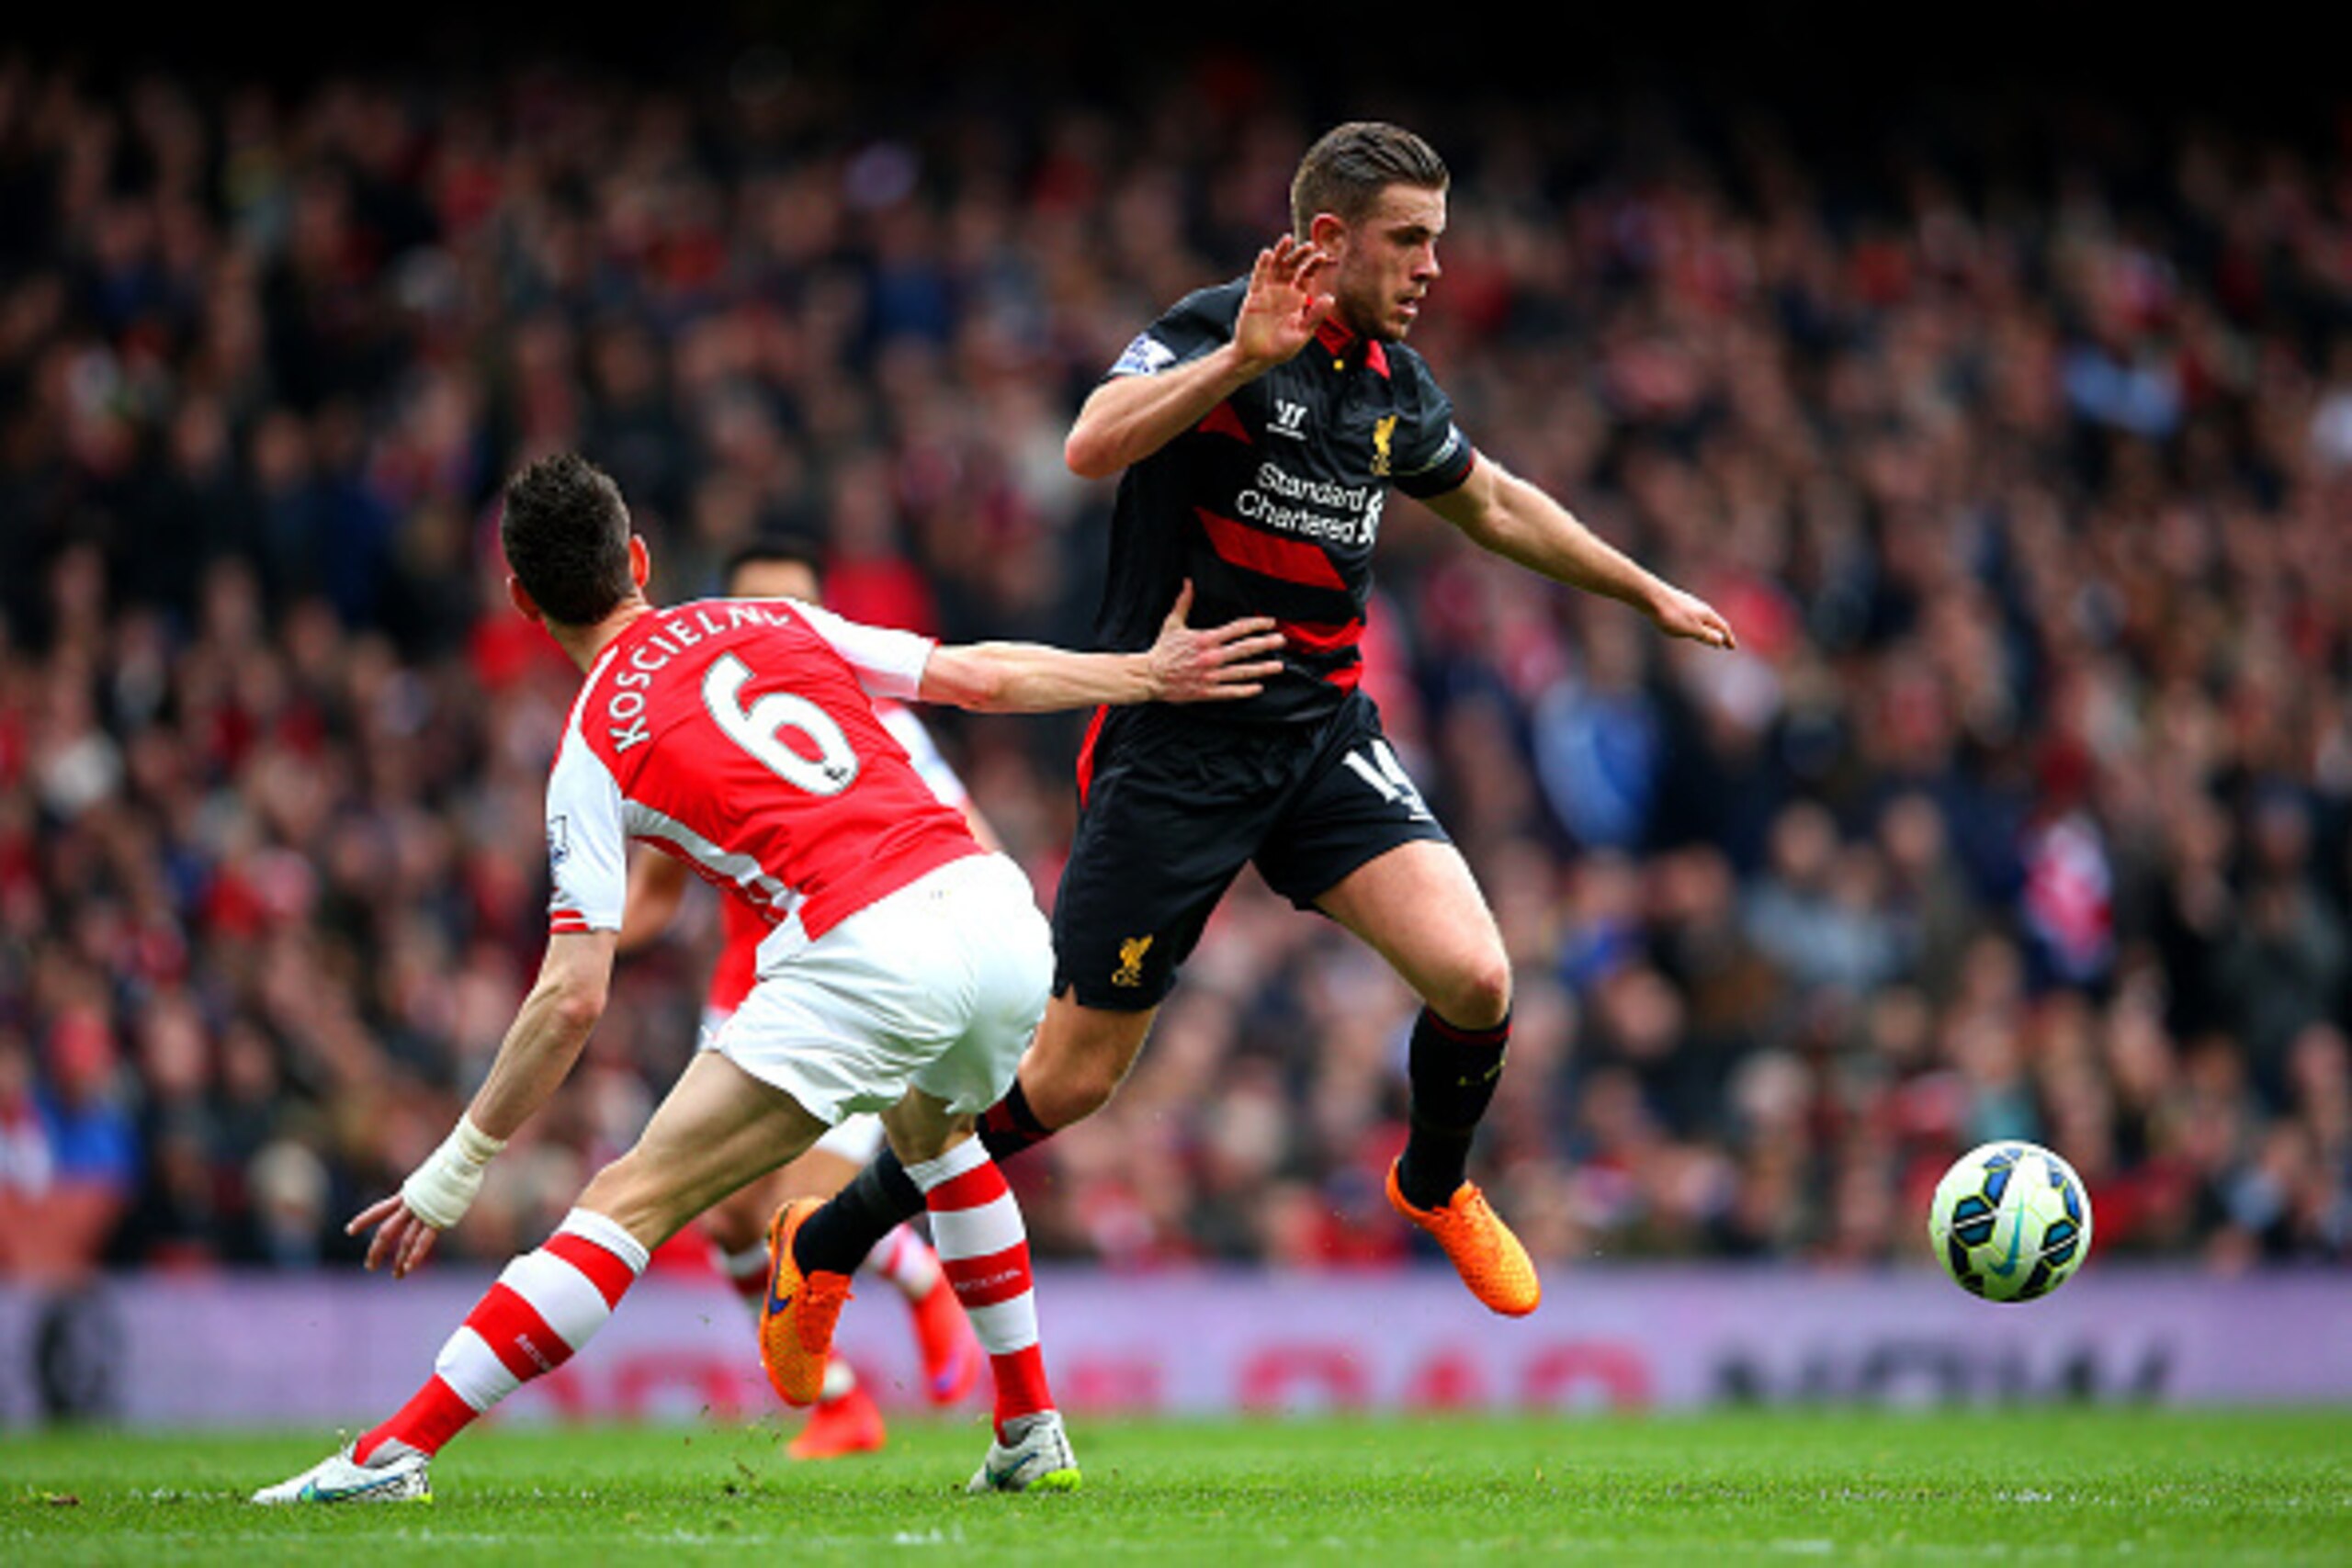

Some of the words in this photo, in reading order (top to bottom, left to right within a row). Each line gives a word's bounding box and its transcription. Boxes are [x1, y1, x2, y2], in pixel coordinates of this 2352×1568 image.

[1257, 461, 1368, 512] Standard
[1237, 490, 1360, 544] Chartered
[701, 651, 860, 795] 6
